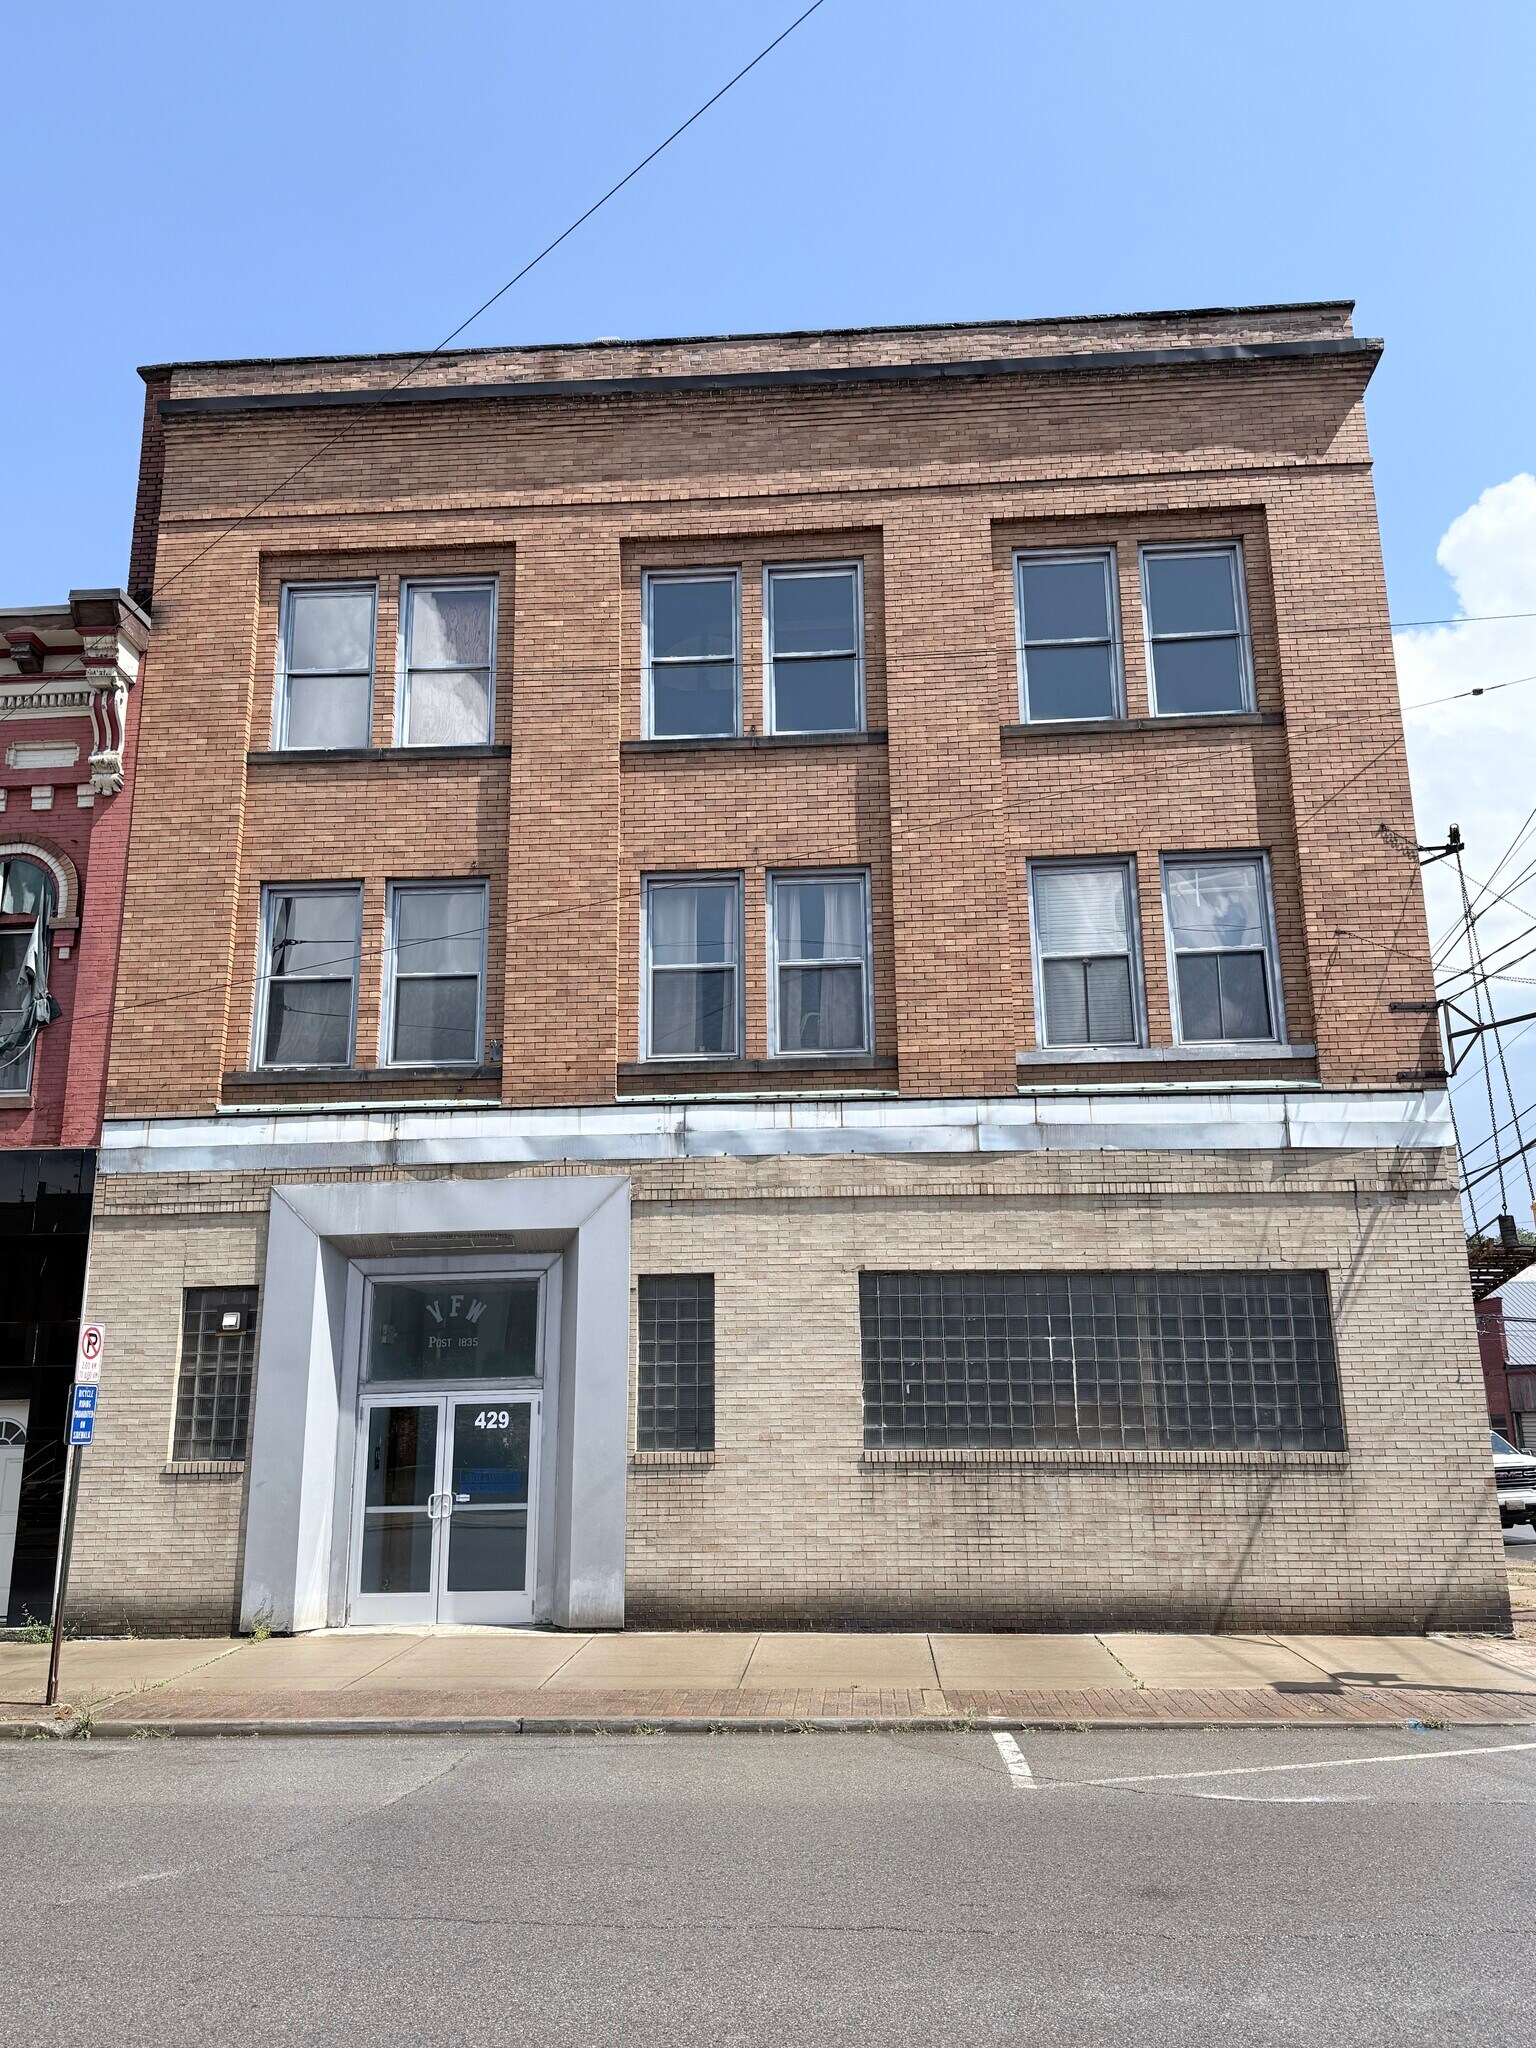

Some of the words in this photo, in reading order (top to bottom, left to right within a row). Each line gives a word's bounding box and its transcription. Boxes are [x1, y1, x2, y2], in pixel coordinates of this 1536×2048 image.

[426, 1294, 487, 1324] VFW
[458, 1337, 478, 1347] 1835
[78, 1389, 94, 1398] BICYCLE
[78, 1399, 92, 1408] RIDING
[74, 1410, 94, 1419] PROHIBITED
[474, 1410, 510, 1429] 429
[80, 1420, 86, 1429] ON
[73, 1430, 91, 1440] SIDEWALK
